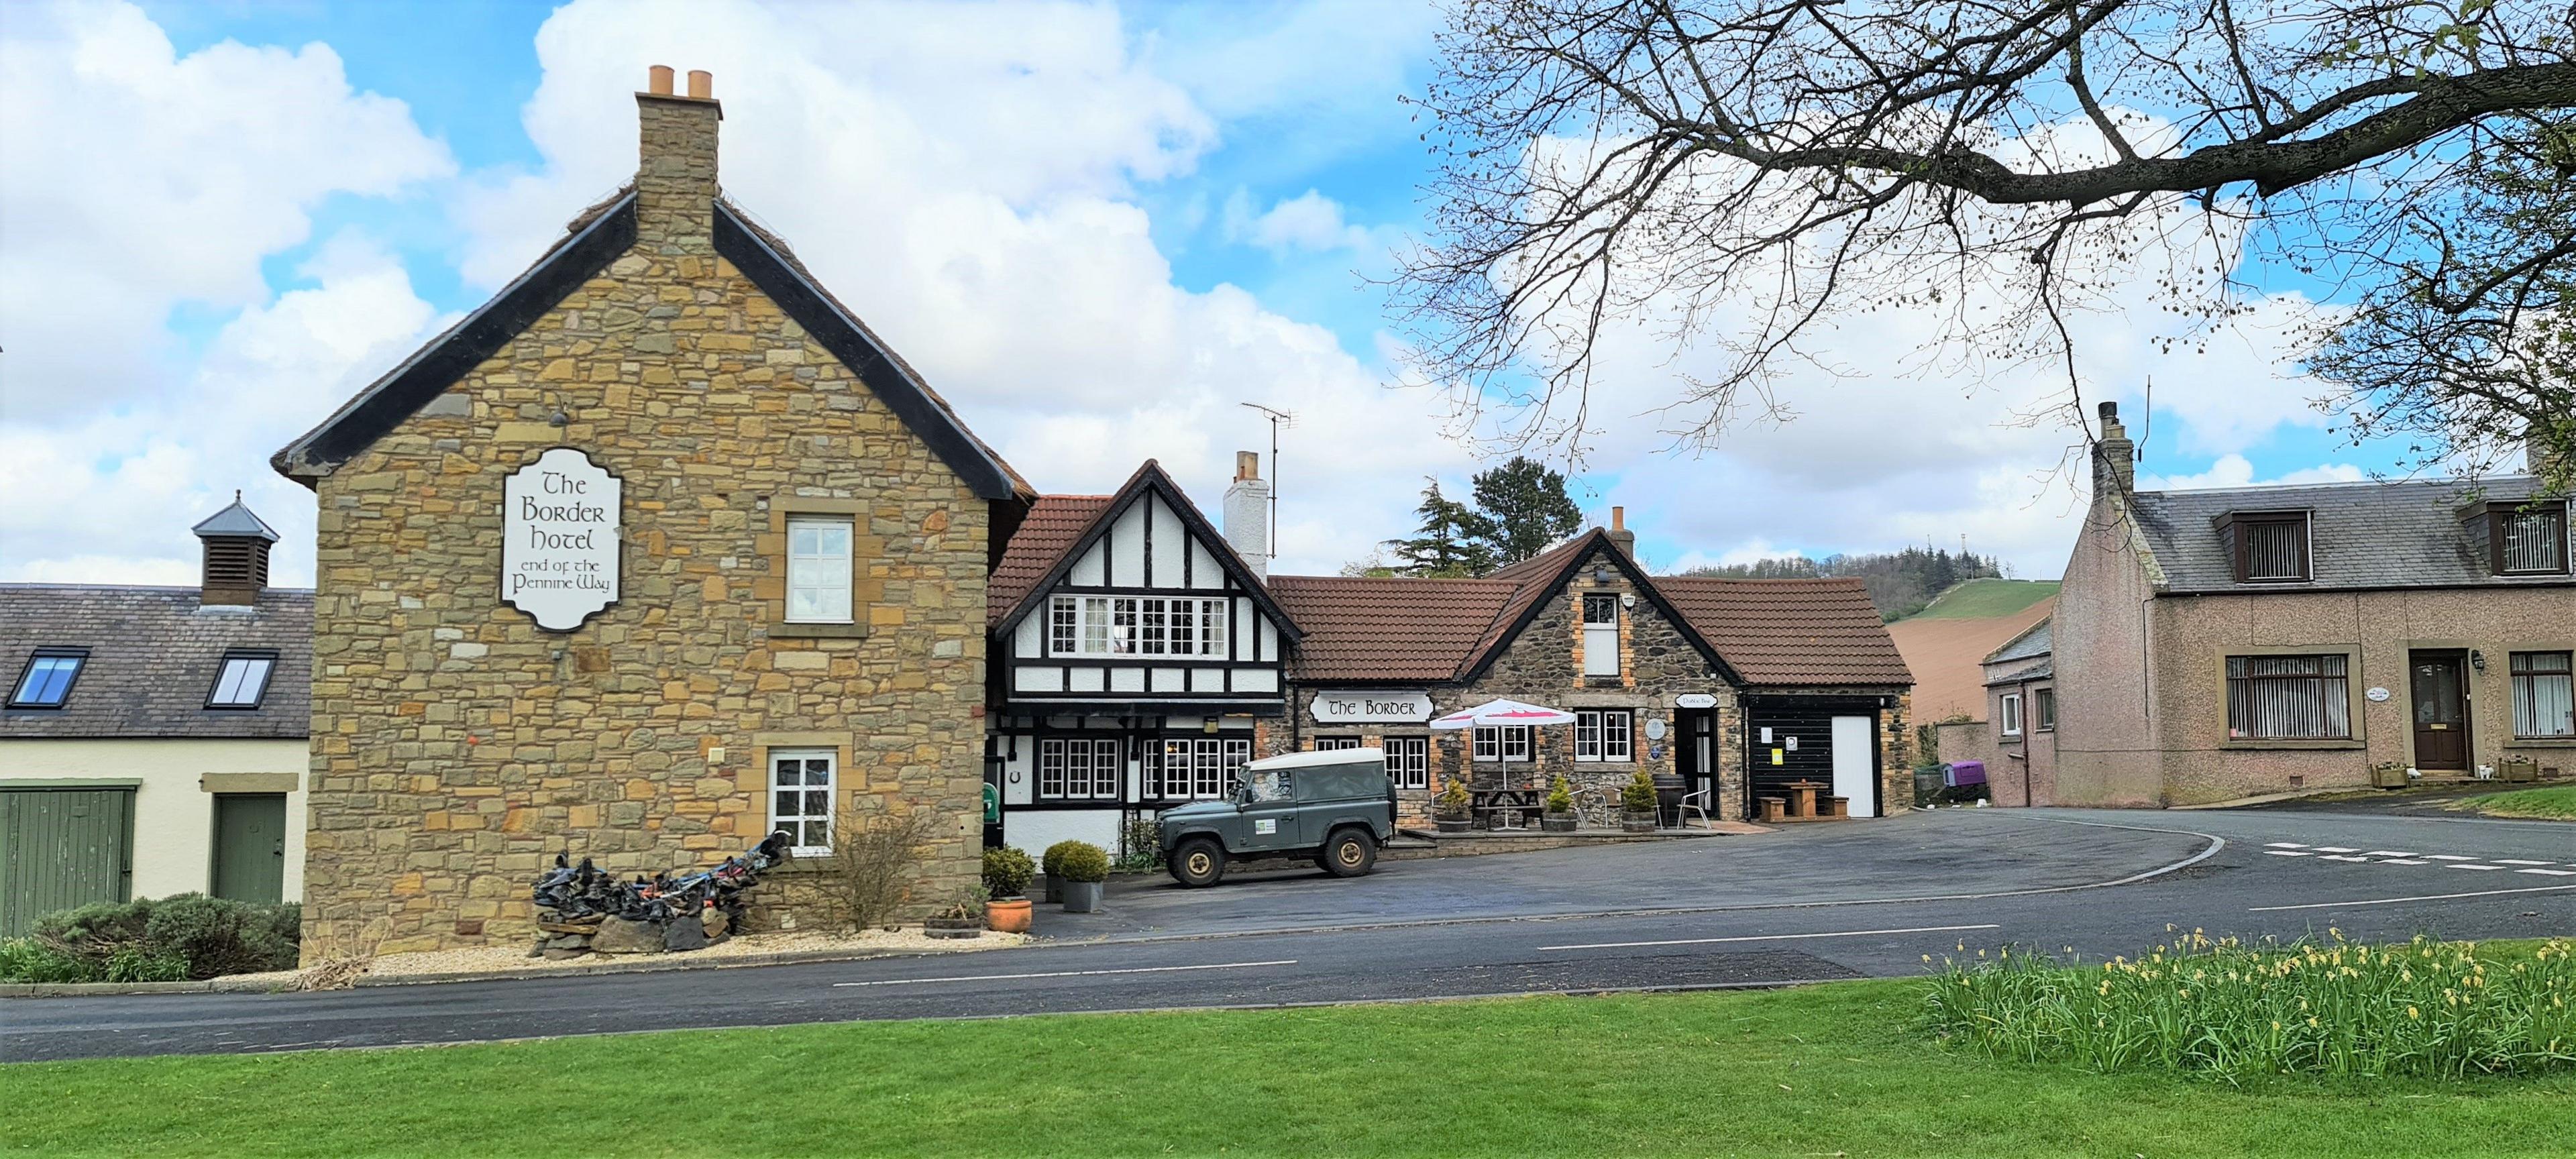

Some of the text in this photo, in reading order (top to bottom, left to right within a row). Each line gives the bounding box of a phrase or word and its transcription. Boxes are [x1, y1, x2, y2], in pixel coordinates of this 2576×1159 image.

[541, 471, 586, 494] The
[521, 496, 605, 522] Border
[521, 559, 600, 575] end of the
[513, 573, 610, 595] Pennine Way
[1329, 700, 1356, 715] The
